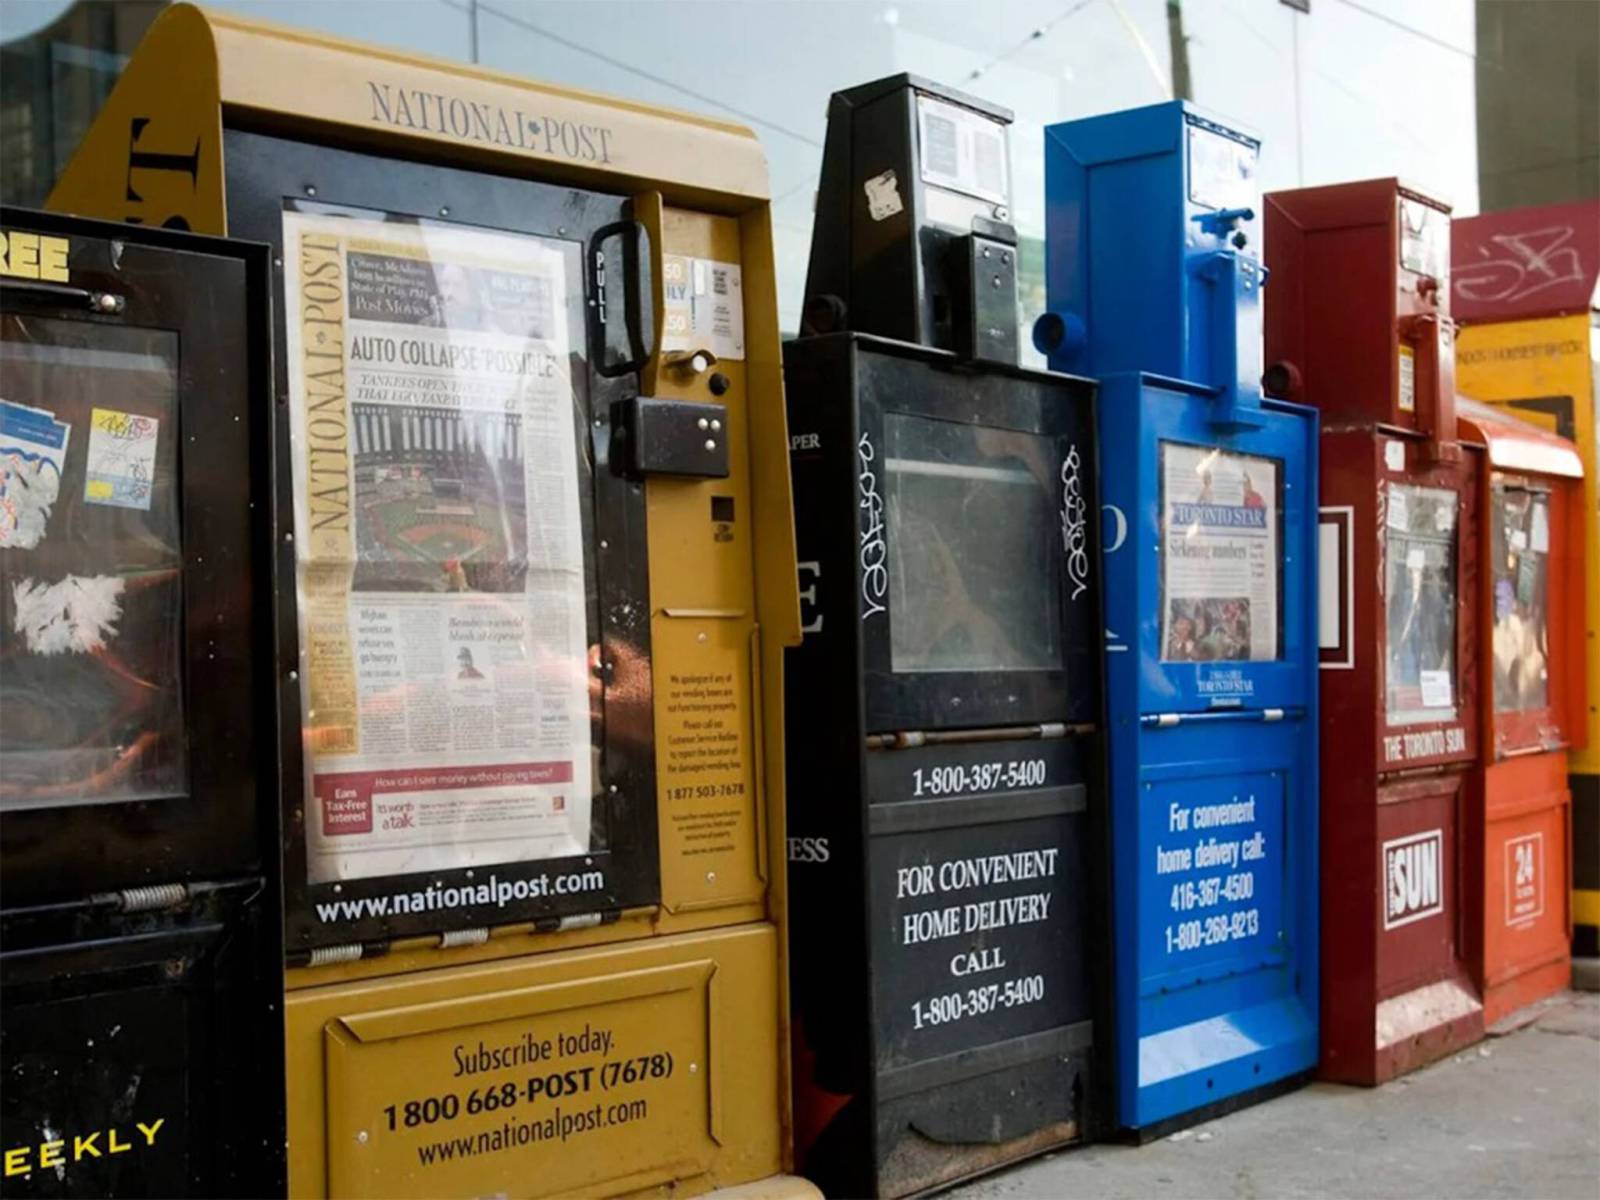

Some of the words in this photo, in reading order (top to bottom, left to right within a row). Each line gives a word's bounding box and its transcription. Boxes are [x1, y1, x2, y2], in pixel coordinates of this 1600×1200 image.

[368, 81, 535, 151] NATIONAL
[541, 116, 612, 164] POST
[301, 234, 343, 326] POST
[596, 251, 606, 323] PULL
[355, 296, 382, 312] Post
[351, 336, 396, 363] AUTO
[400, 339, 478, 370] COLLAPSE
[417, 377, 450, 391] OPEN
[304, 341, 349, 532] NATIONAL
[790, 433, 821, 450] PER
[1178, 505, 1232, 525] TORONTO
[1233, 508, 1264, 527] STAR
[1384, 735, 1402, 762] THE
[1404, 730, 1445, 760] TORONTO
[1447, 728, 1465, 756] SUN
[375, 776, 394, 788] How
[439, 774, 467, 787] money
[469, 771, 501, 783] without
[674, 787, 693, 800] 877
[696, 783, 744, 798] 503-7678
[912, 760, 1046, 796] 1-800-387-5400
[326, 800, 368, 813] Tax-Free
[328, 812, 366, 823] Interest
[1169, 803, 1190, 832] For
[1193, 795, 1255, 829] convenient
[897, 865, 934, 898] FOR
[939, 849, 1058, 891] CONVENIENT
[1157, 845, 1192, 874] home
[1195, 837, 1239, 869] delivery
[1242, 831, 1265, 861] call:
[1515, 842, 1534, 885] 24
[317, 869, 605, 924] www.nationalpost.com
[1170, 872, 1253, 912] 416-367-4500
[1394, 840, 1438, 915] SUN
[903, 907, 960, 944] HOME
[964, 893, 1051, 933] DELIVERY
[1165, 909, 1259, 954] 1-800-268-9213
[951, 947, 1006, 976] CALL
[911, 975, 1044, 1030] 1-800-387-5400
[453, 1033, 551, 1077] Subscribe
[559, 1024, 615, 1059] today.
[384, 1104, 396, 1131] 1
[404, 1094, 459, 1128] 800
[467, 1067, 594, 1115] 668-POST
[600, 1051, 674, 1090] (7678)
[418, 1099, 647, 1166] www.nationalpost.com
